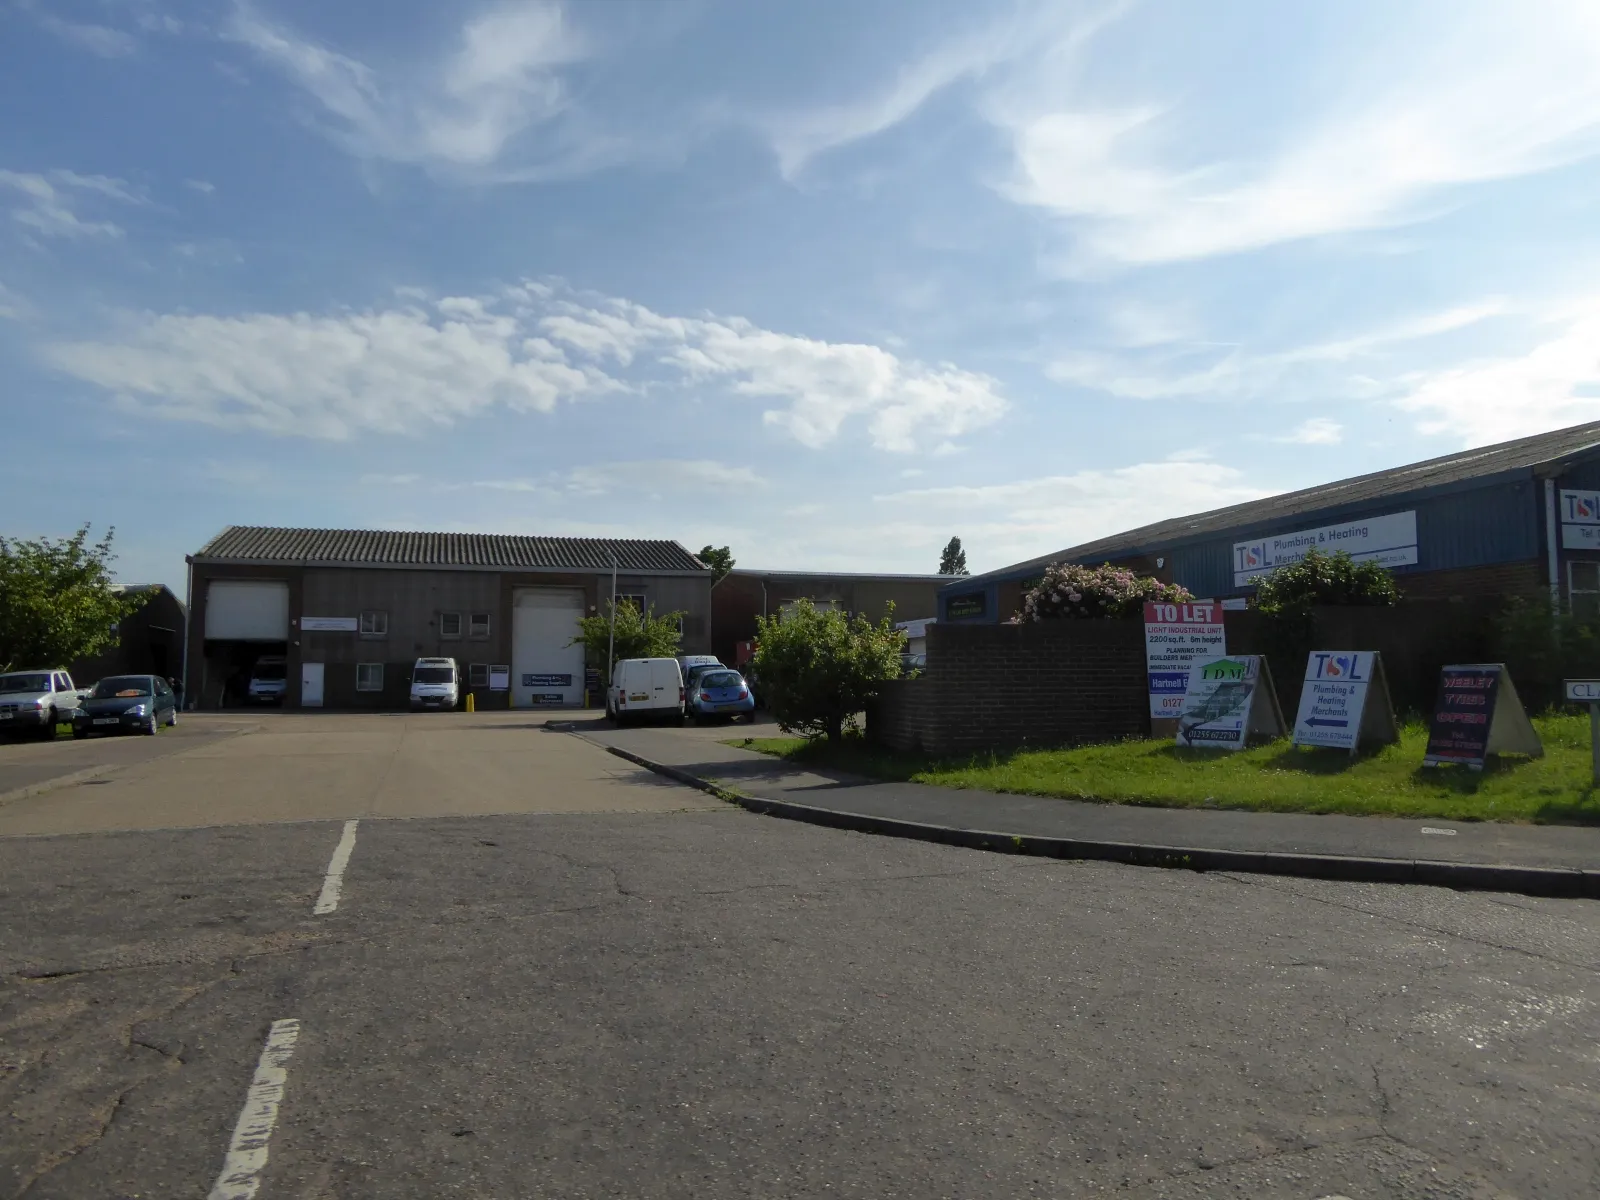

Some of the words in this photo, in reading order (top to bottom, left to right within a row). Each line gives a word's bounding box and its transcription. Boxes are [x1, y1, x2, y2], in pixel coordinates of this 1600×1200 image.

[1274, 536, 1316, 550] Plumbing
[1318, 533, 1325, 542] &
[1329, 527, 1368, 541] Heating
[1274, 553, 1307, 565] Mercha
[1154, 604, 1178, 622] TO
[1182, 605, 1214, 623] LET
[1201, 636, 1222, 645] height
[1152, 678, 1182, 688] Hartnell
[1444, 677, 1494, 689] WEELEY
[1313, 684, 1347, 696] Plumbing
[1349, 685, 1355, 695] &
[1572, 684, 1600, 697] CL
[1317, 695, 1346, 707] Heating
[1310, 706, 1348, 716] Merchants
[1437, 712, 1487, 724] OPEN
